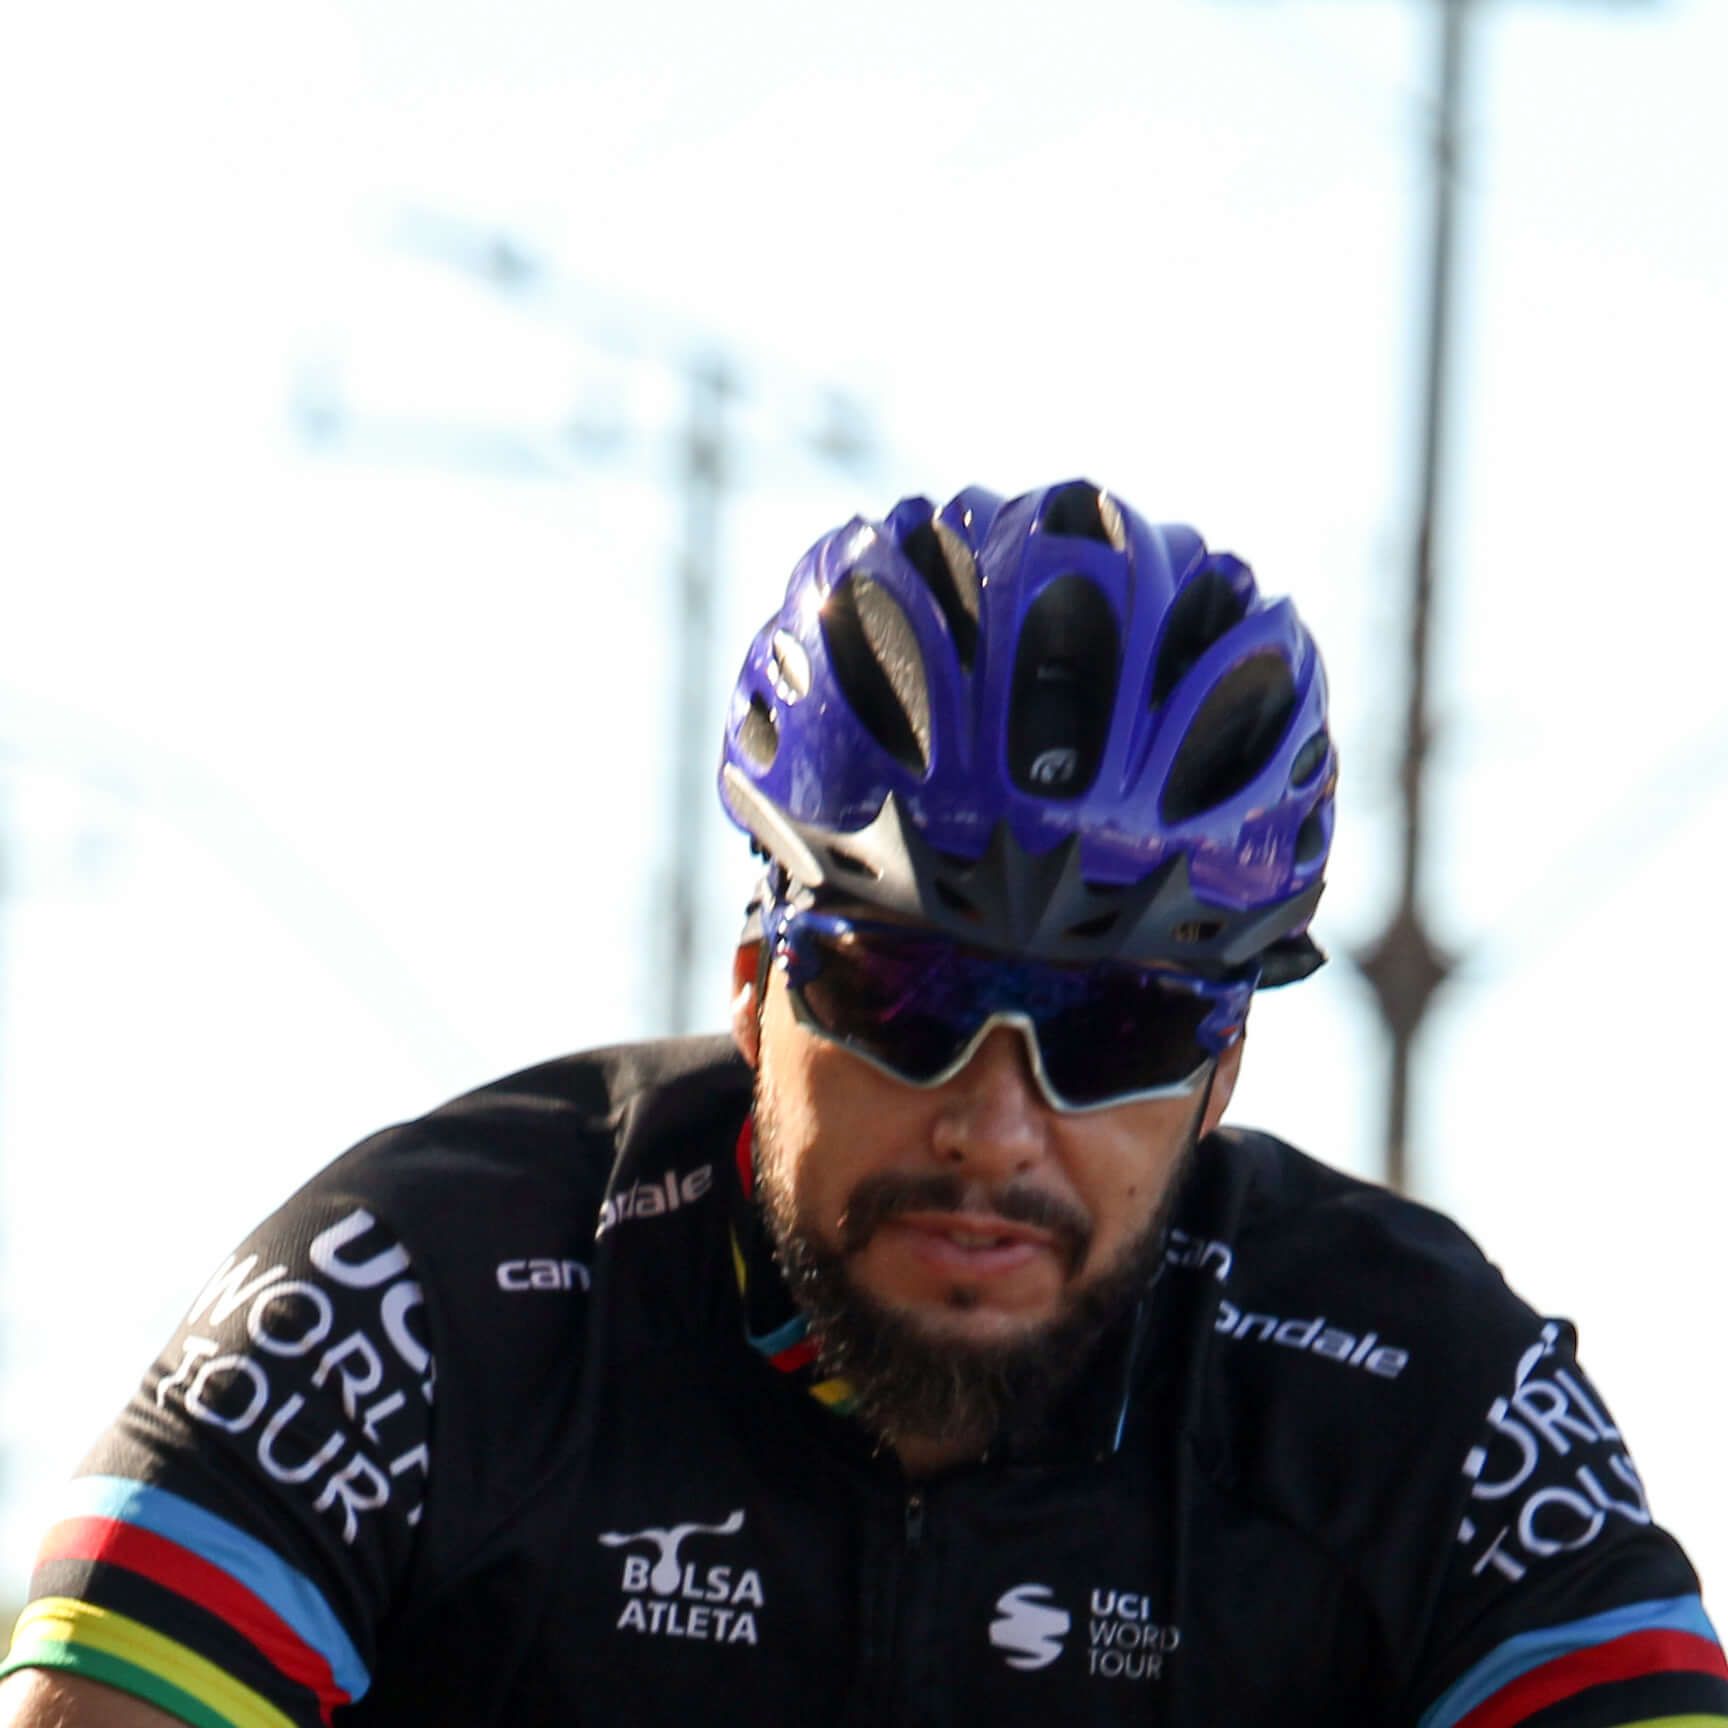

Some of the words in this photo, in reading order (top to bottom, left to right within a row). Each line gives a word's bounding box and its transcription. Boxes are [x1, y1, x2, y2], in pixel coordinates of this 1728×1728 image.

[309, 1207, 436, 1404] UC
[156, 1335, 390, 1544] TOUR
[1472, 1454, 1650, 1582] TOU
[621, 1553, 764, 1608] BOLSA
[1090, 1587, 1151, 1621] UCI
[616, 1598, 758, 1646] ATLETA
[1087, 1646, 1165, 1681] TOUR
